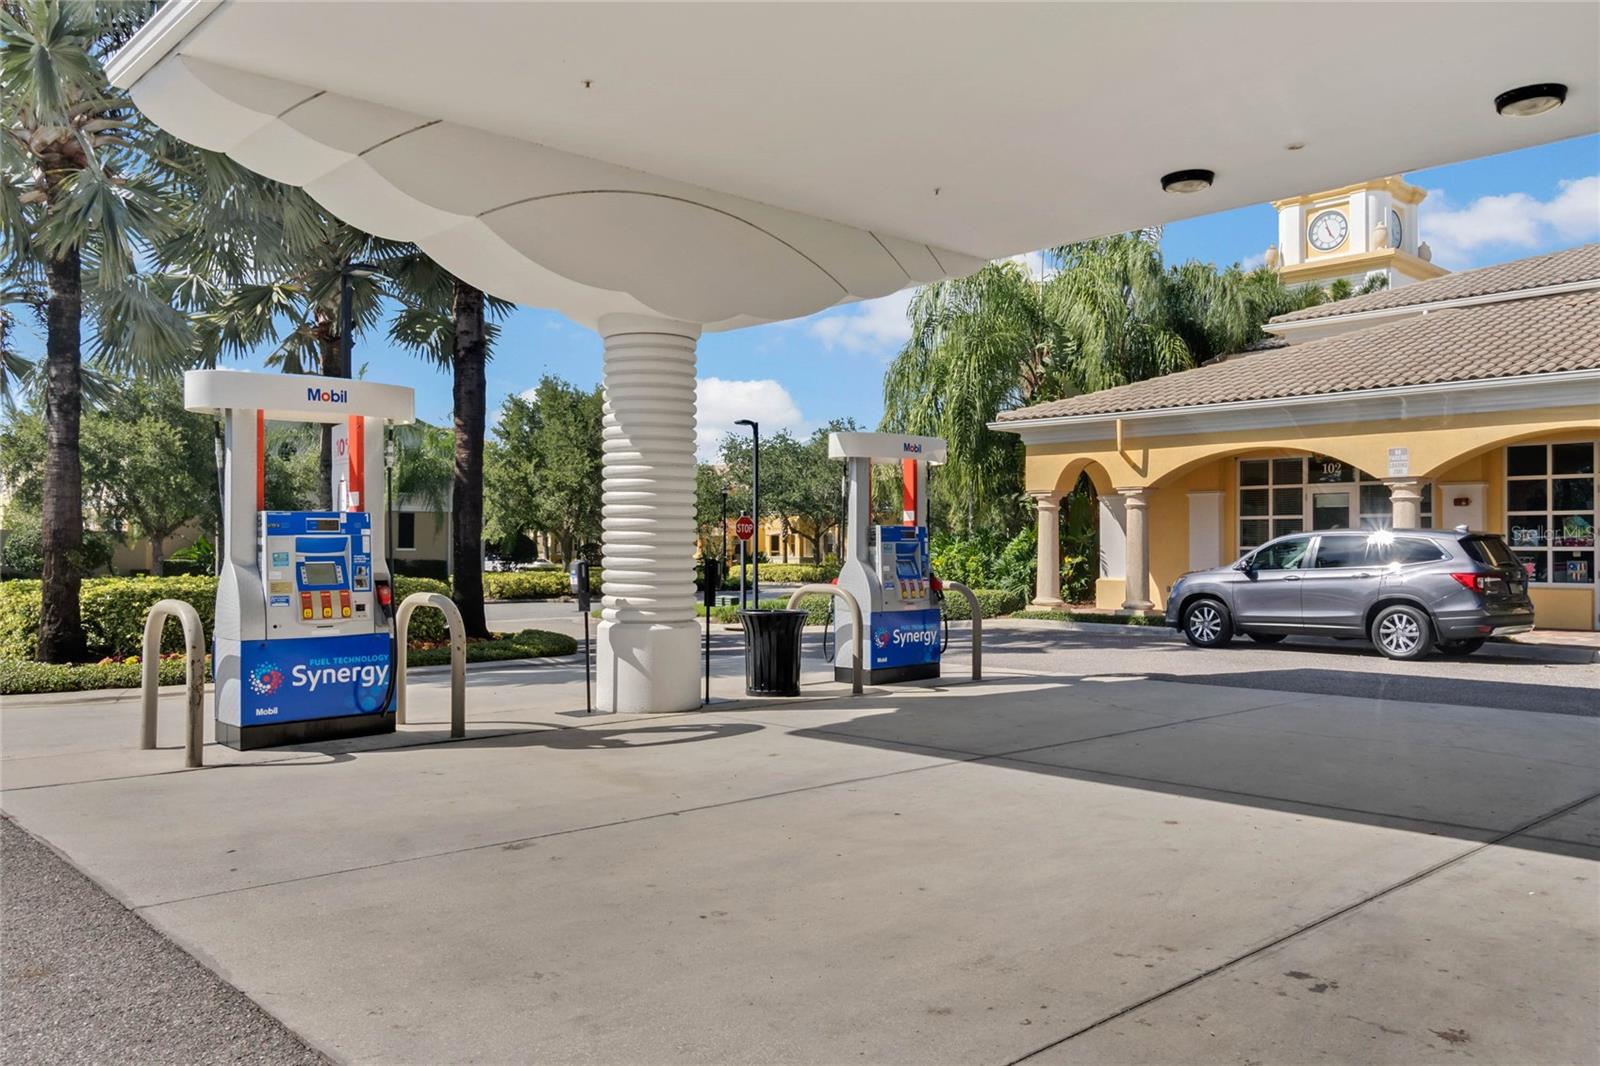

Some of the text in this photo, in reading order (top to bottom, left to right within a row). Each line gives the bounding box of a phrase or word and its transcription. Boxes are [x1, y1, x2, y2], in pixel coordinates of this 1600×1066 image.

[307, 388, 347, 403] Mobil
[904, 442, 922, 454] Mobil
[1322, 463, 1342, 474] 102
[737, 523, 753, 533] STOP
[892, 629, 938, 648] Synergy
[309, 654, 389, 666] FUEL TECHNOLOGY
[292, 664, 390, 692] Synergy
[256, 707, 278, 716] Mobil
